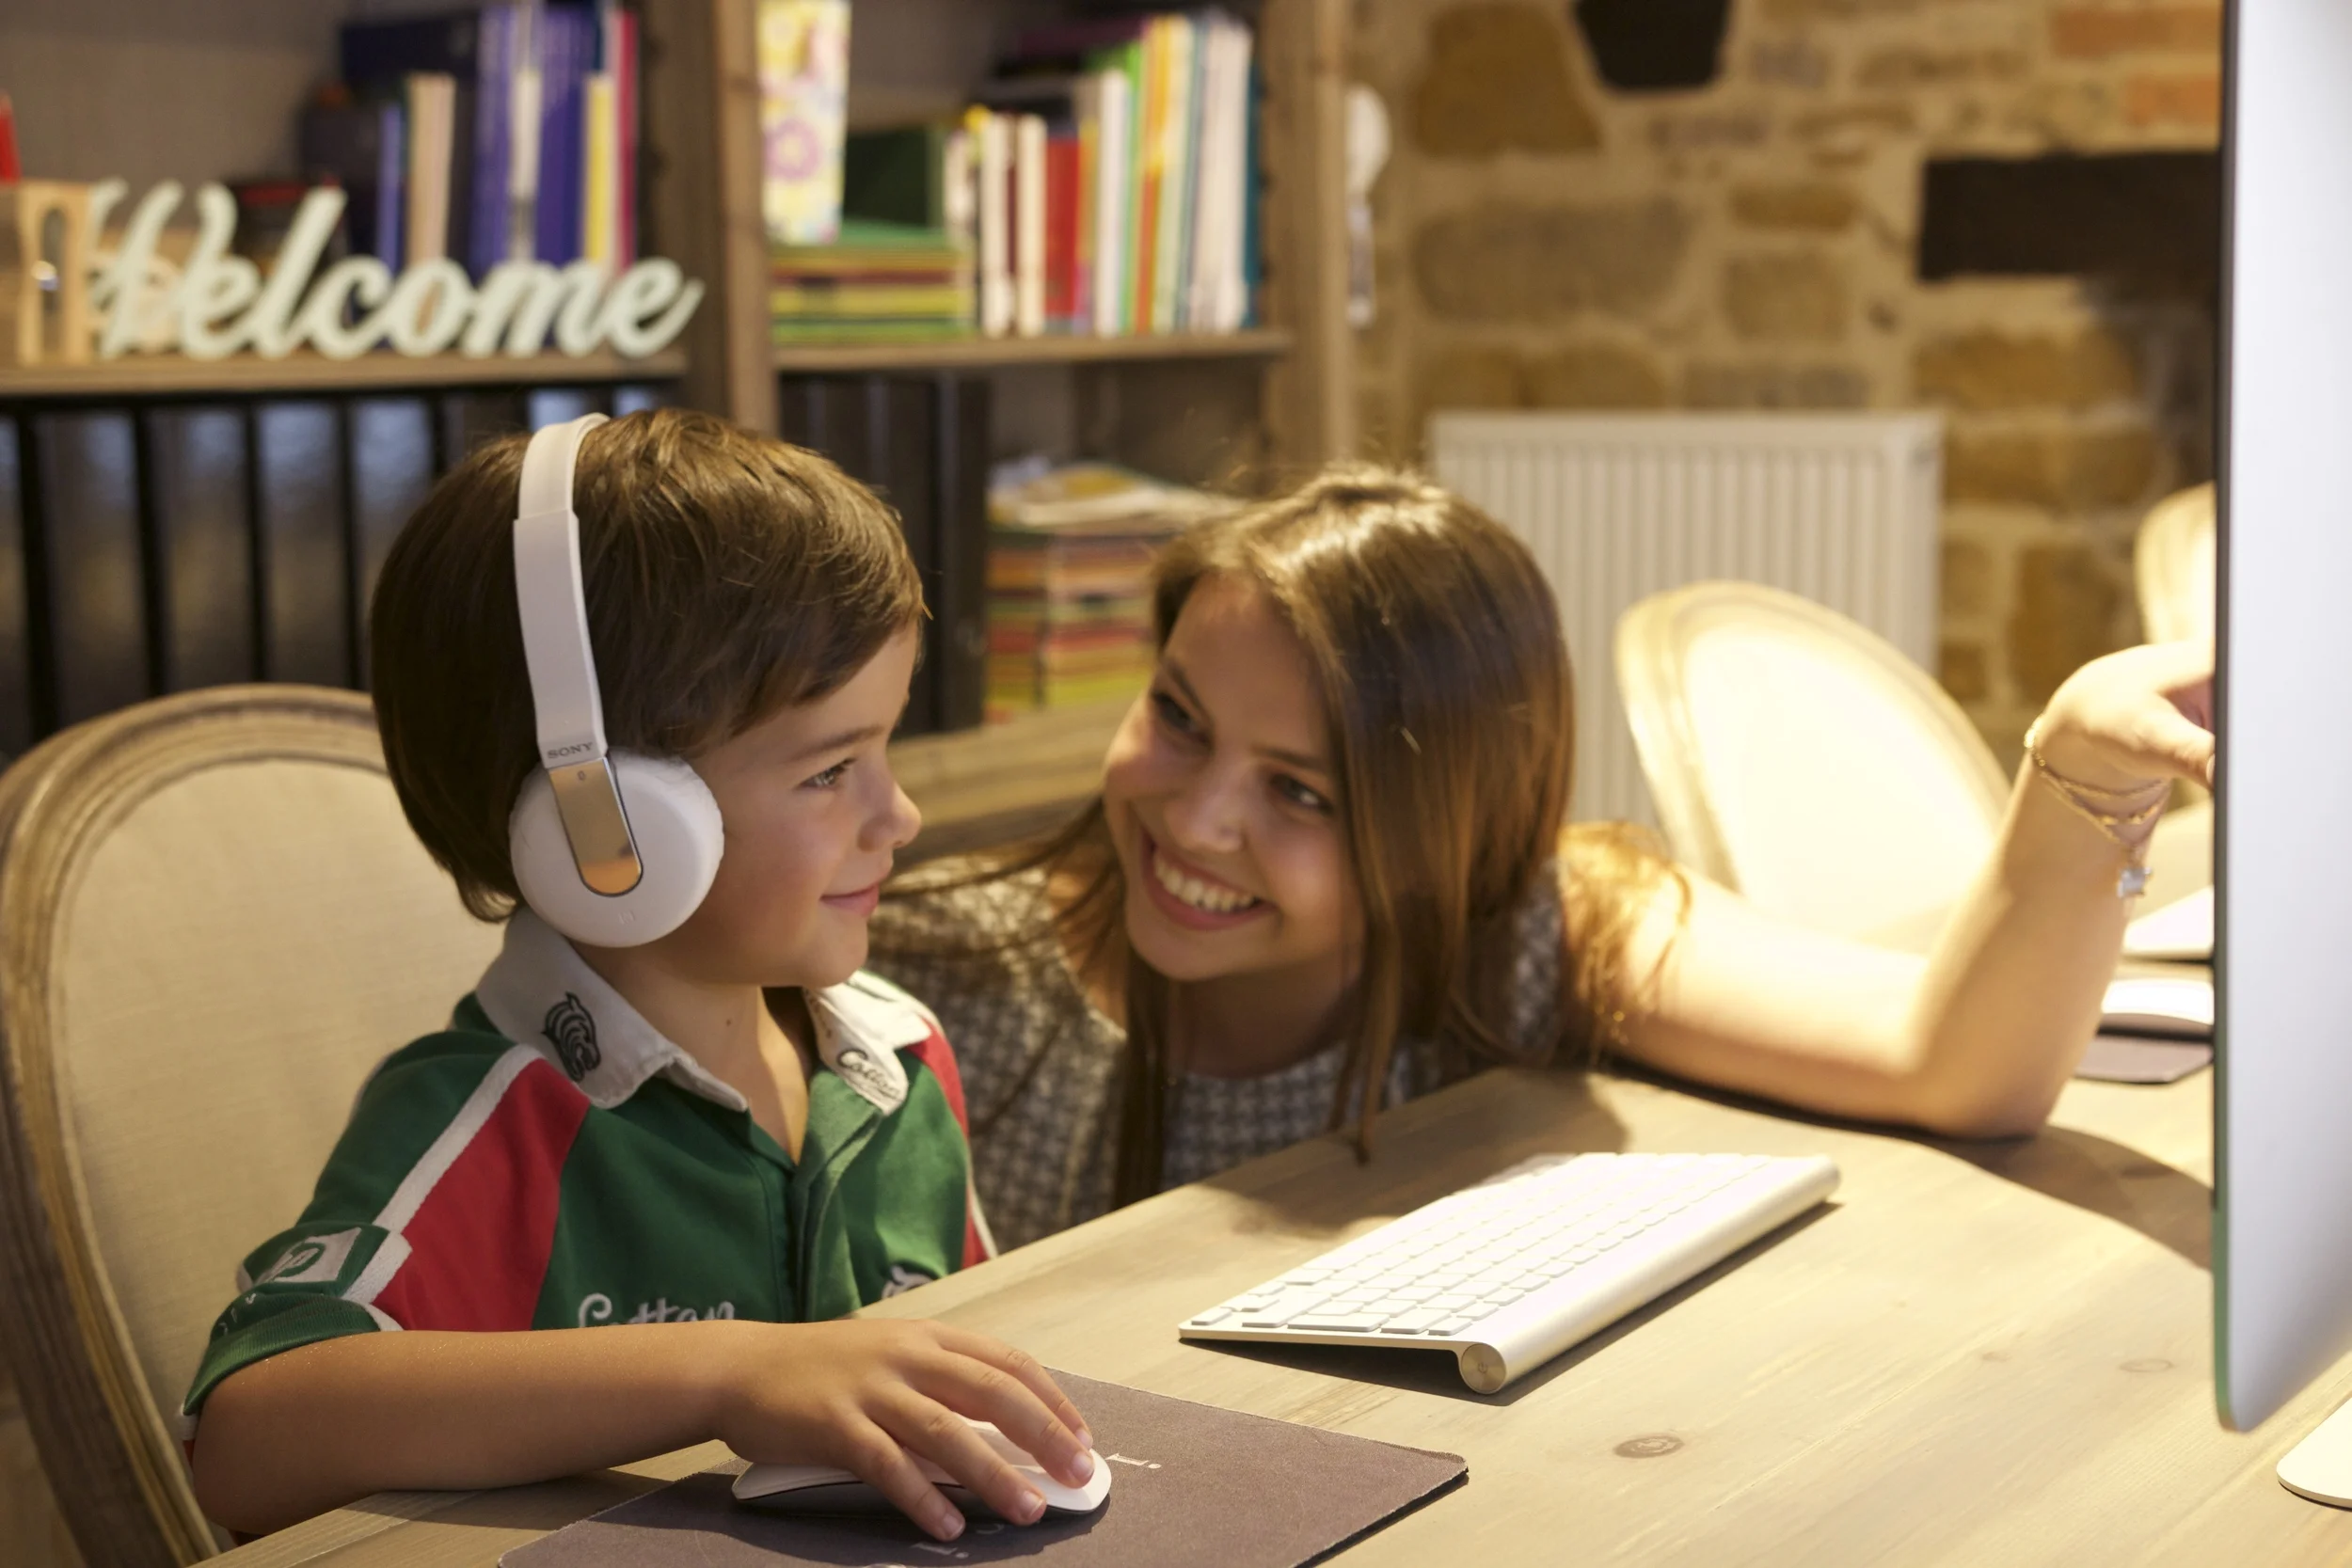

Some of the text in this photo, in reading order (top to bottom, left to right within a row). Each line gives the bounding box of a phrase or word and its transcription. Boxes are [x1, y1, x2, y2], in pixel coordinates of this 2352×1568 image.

[91, 180, 705, 360] Welcome
[548, 741, 594, 759] SONY
[578, 1291, 736, 1329] Ctton
